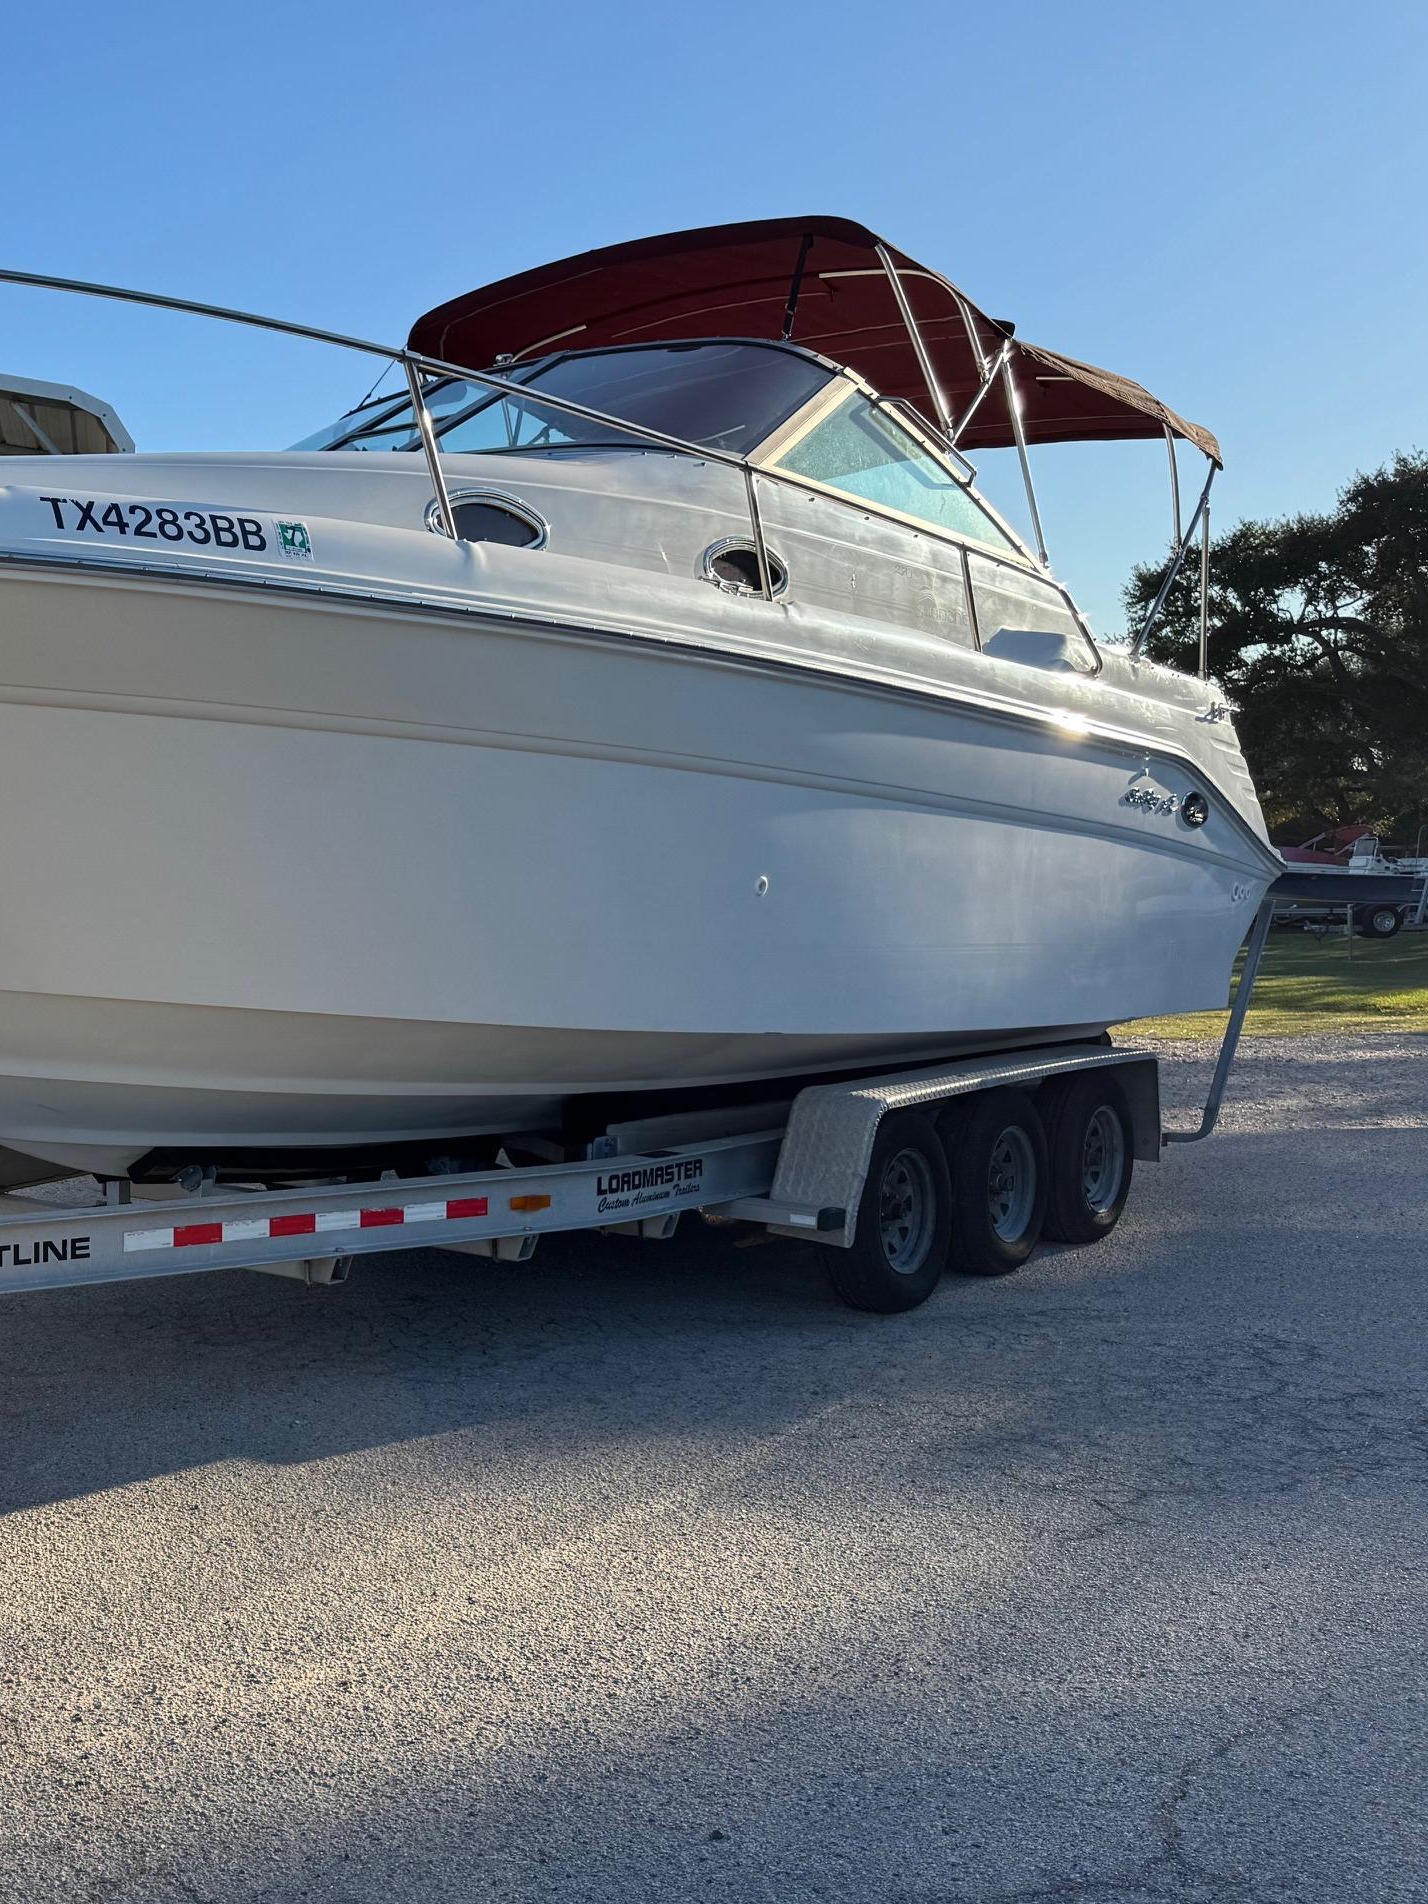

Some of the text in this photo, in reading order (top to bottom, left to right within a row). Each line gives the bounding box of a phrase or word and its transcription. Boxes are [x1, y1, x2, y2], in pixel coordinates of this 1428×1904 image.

[39, 496, 267, 552] TX4283BB
[596, 1159, 702, 1196] LOADMASTER
[597, 1182, 701, 1213] Custom Aluminum Trailers
